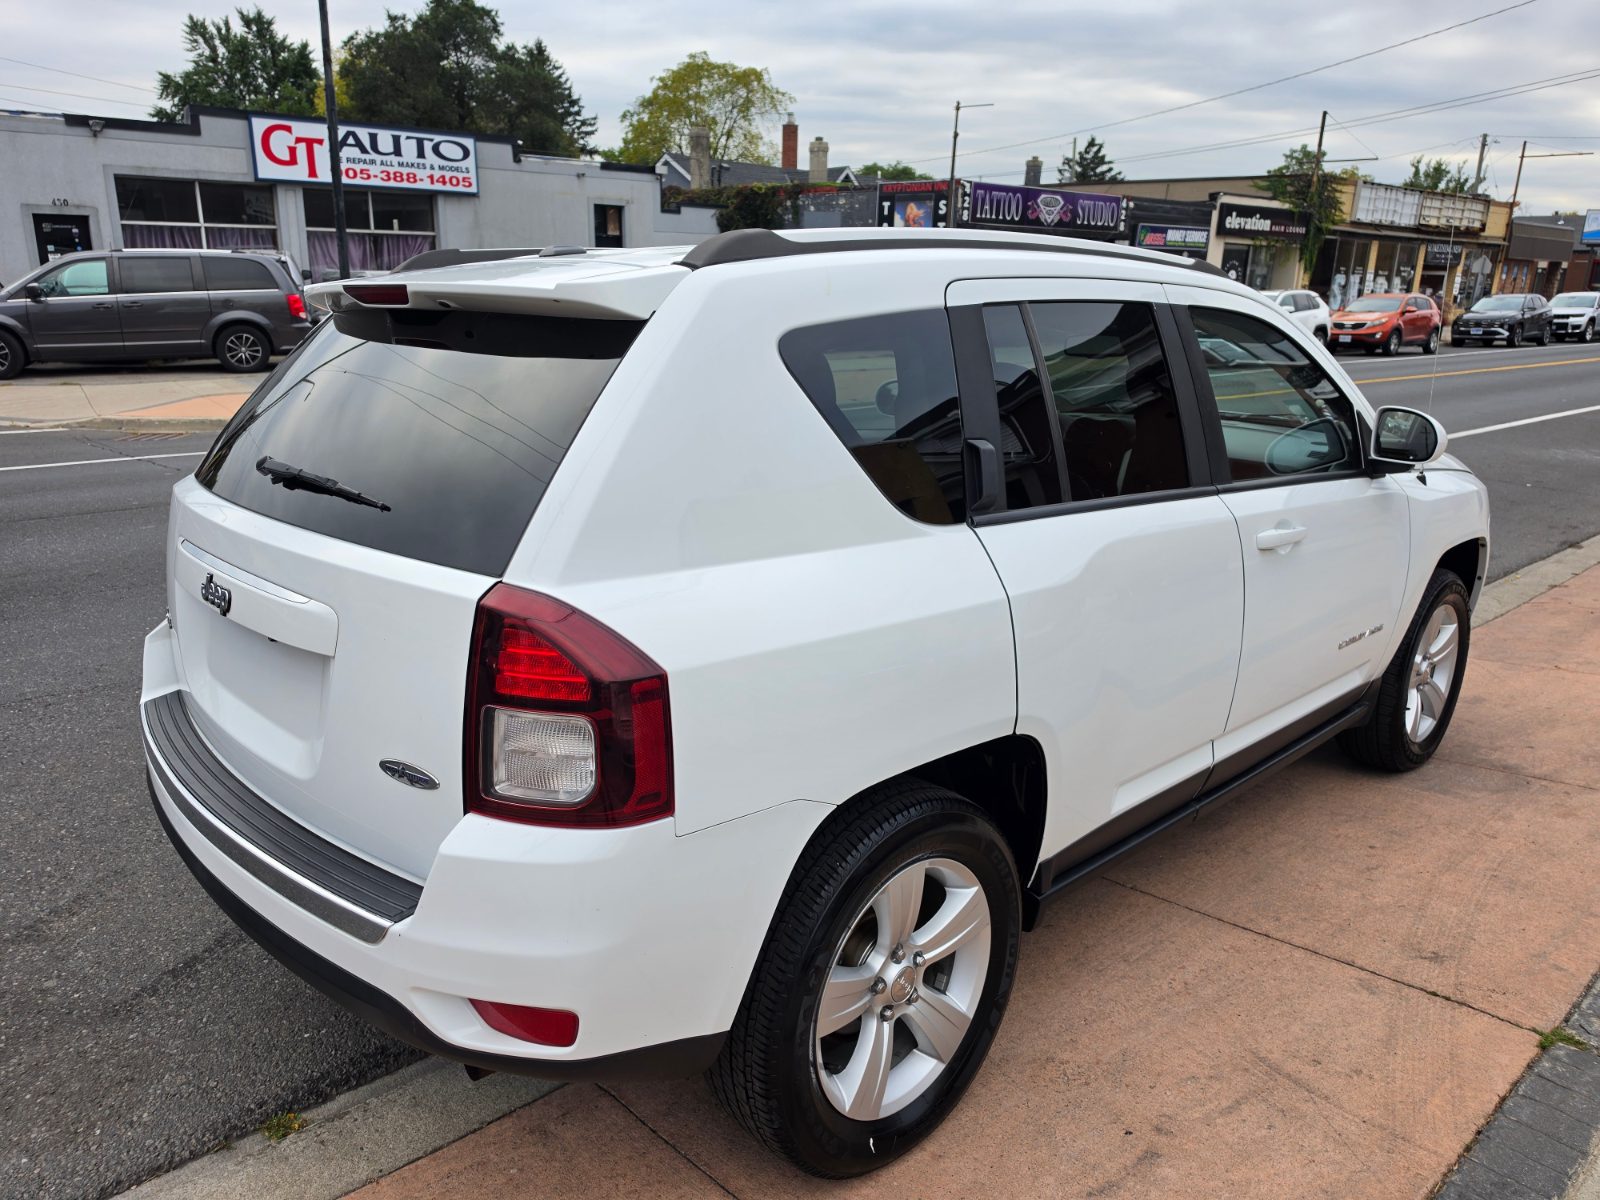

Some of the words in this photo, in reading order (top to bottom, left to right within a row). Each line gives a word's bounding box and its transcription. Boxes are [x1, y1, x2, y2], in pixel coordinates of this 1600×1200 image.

[260, 123, 324, 178] GT
[338, 130, 471, 163] AUTO
[346, 156, 377, 166] REPAIR
[380, 159, 395, 167] ALL
[398, 161, 427, 171] MAKES
[429, 163, 435, 171] &
[438, 164, 470, 174] MODELS
[339, 167, 473, 188] 05-388-1405
[976, 189, 1023, 221] TATTOO
[1077, 199, 1118, 227] STUDIO
[1225, 211, 1272, 232] elevation
[201, 572, 232, 617] Jeep
